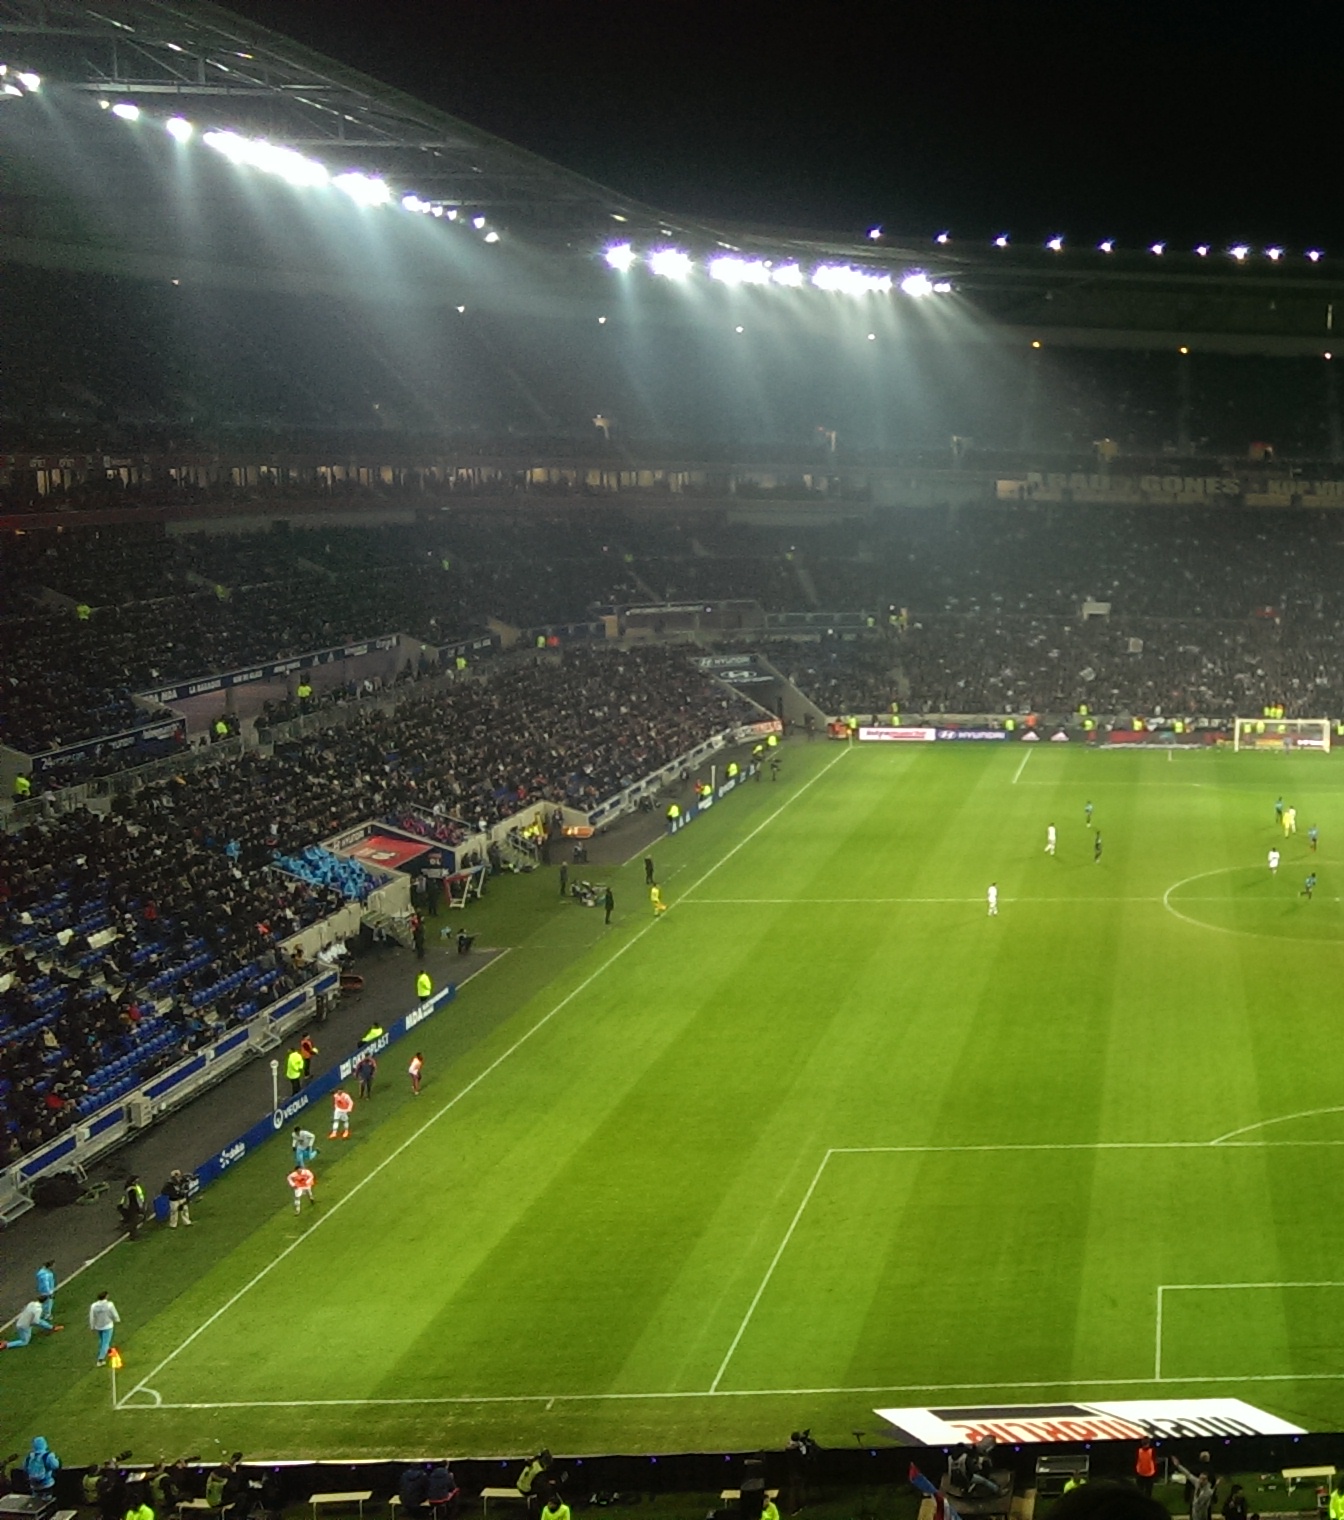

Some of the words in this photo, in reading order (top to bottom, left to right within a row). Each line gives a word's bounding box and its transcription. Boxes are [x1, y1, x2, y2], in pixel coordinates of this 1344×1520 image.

[1141, 474, 1241, 494] GONES
[958, 731, 1005, 740] HYUNDAI
[283, 1095, 309, 1119] VEOLIA
